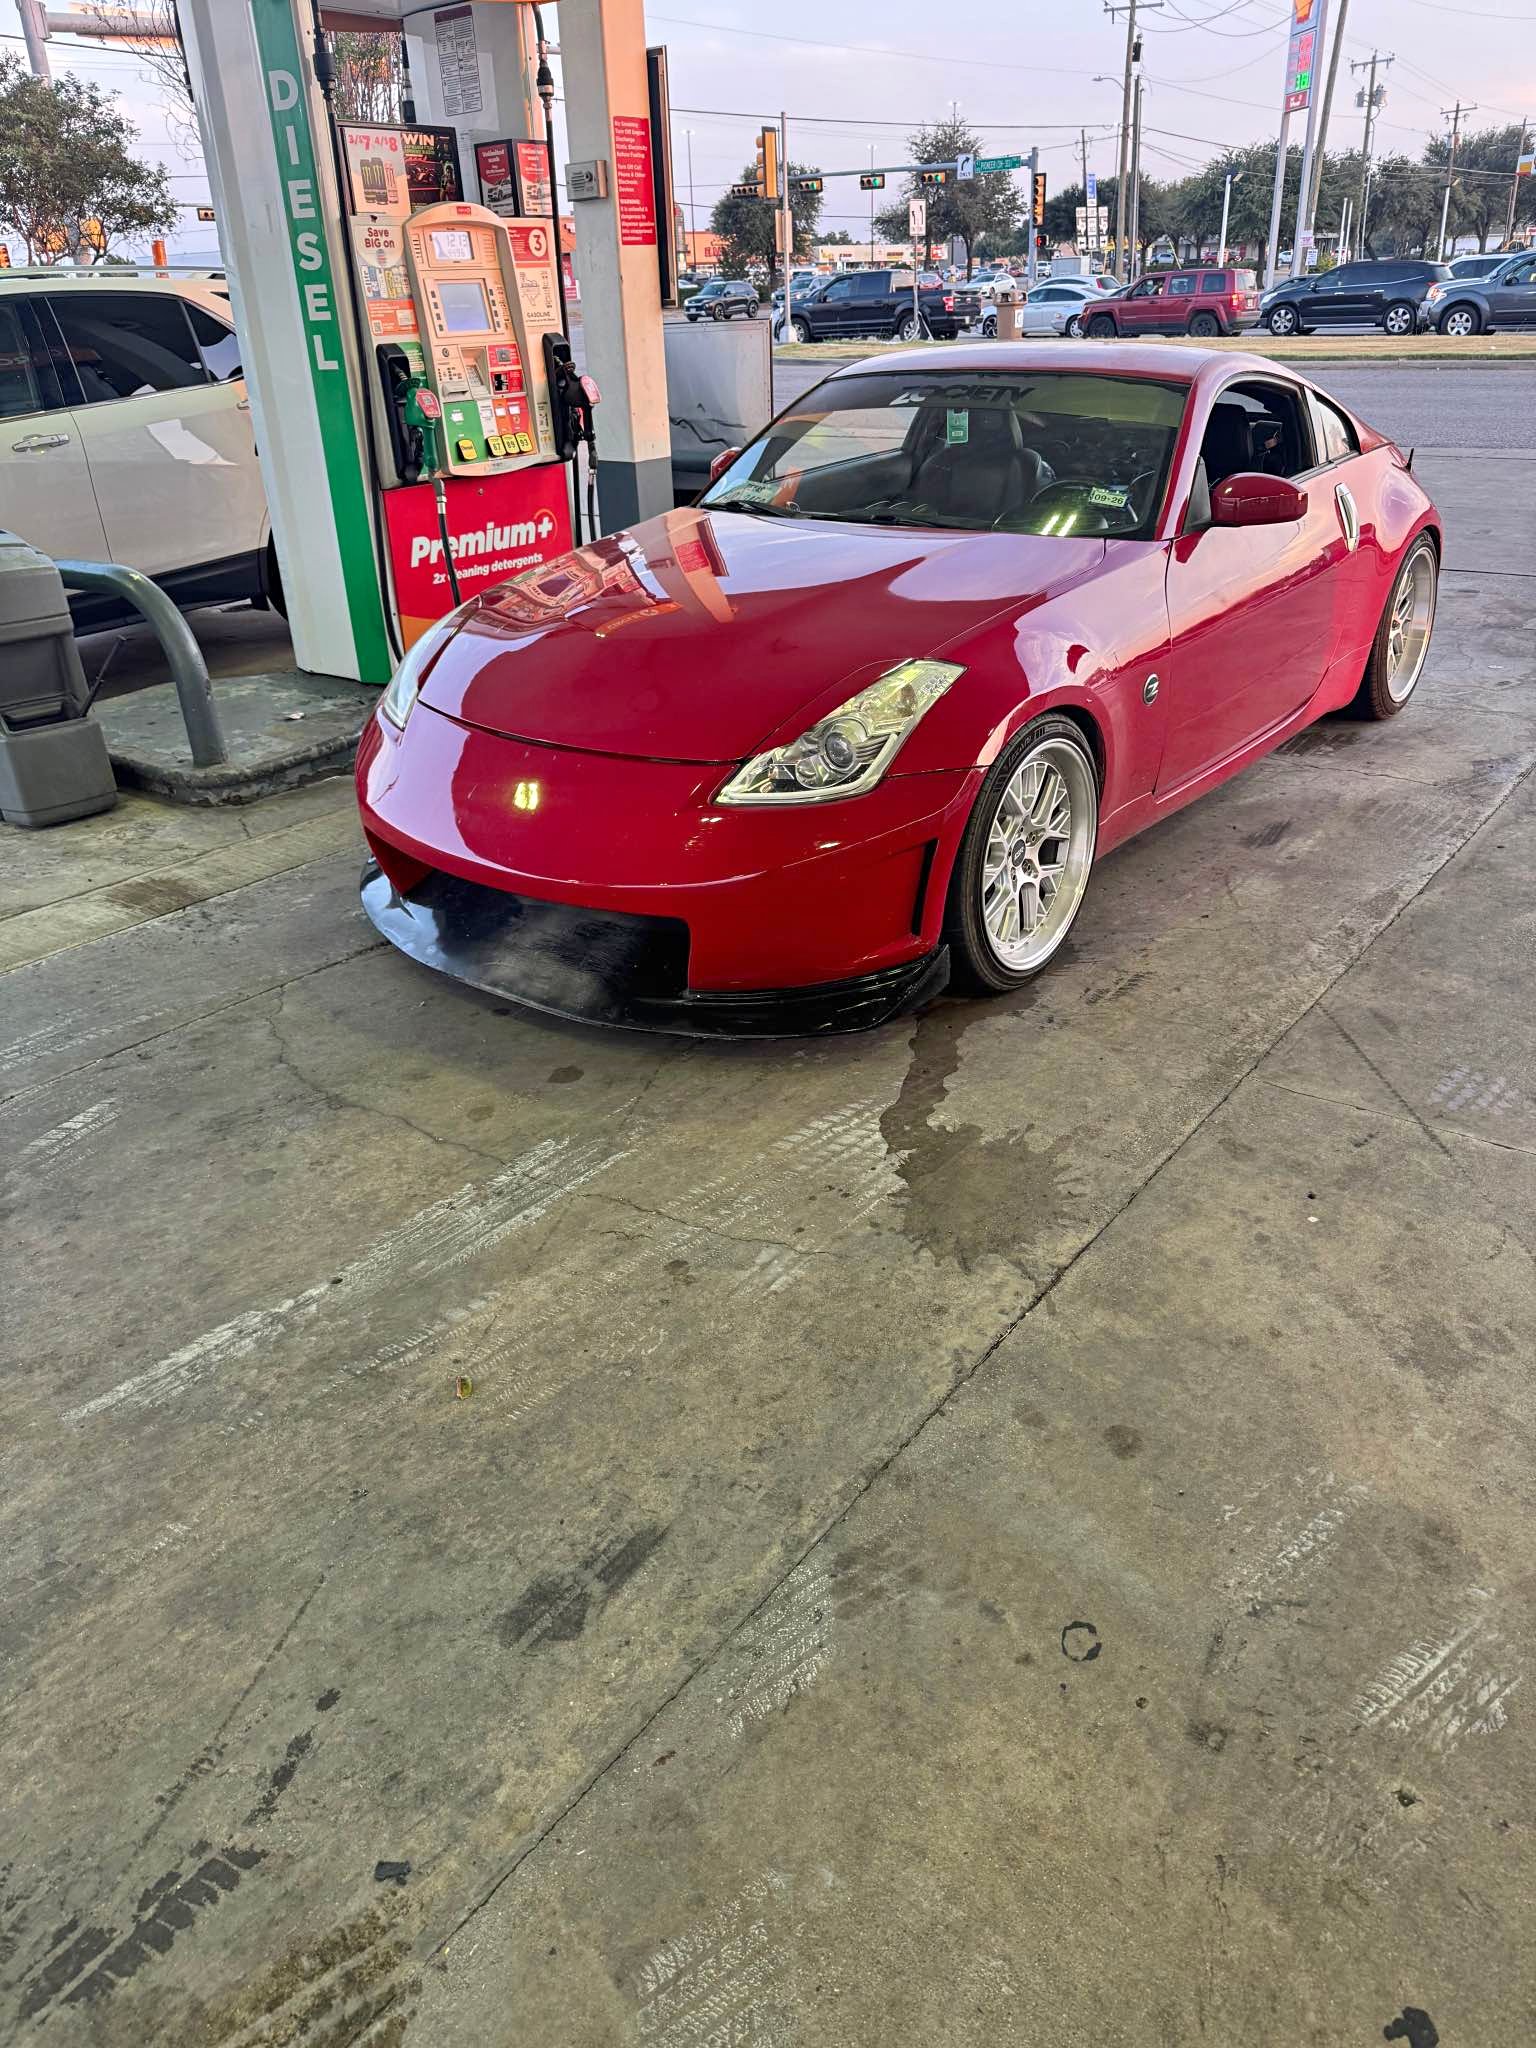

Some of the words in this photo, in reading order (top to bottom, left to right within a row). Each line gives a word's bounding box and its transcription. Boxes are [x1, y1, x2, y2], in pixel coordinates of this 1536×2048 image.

[401, 133, 435, 146] WIN
[268, 70, 339, 370] DIESEL
[367, 227, 389, 238] Save
[364, 239, 382, 249] BIG
[383, 239, 395, 249] on
[533, 234, 542, 252] 3
[507, 441, 516, 449] 89
[520, 439, 529, 447] 93
[1094, 494, 1125, 505] 09-26
[411, 516, 553, 568] Premium+
[433, 573, 447, 585] 2x
[448, 563, 489, 581] leaning
[491, 552, 543, 572] detergents
